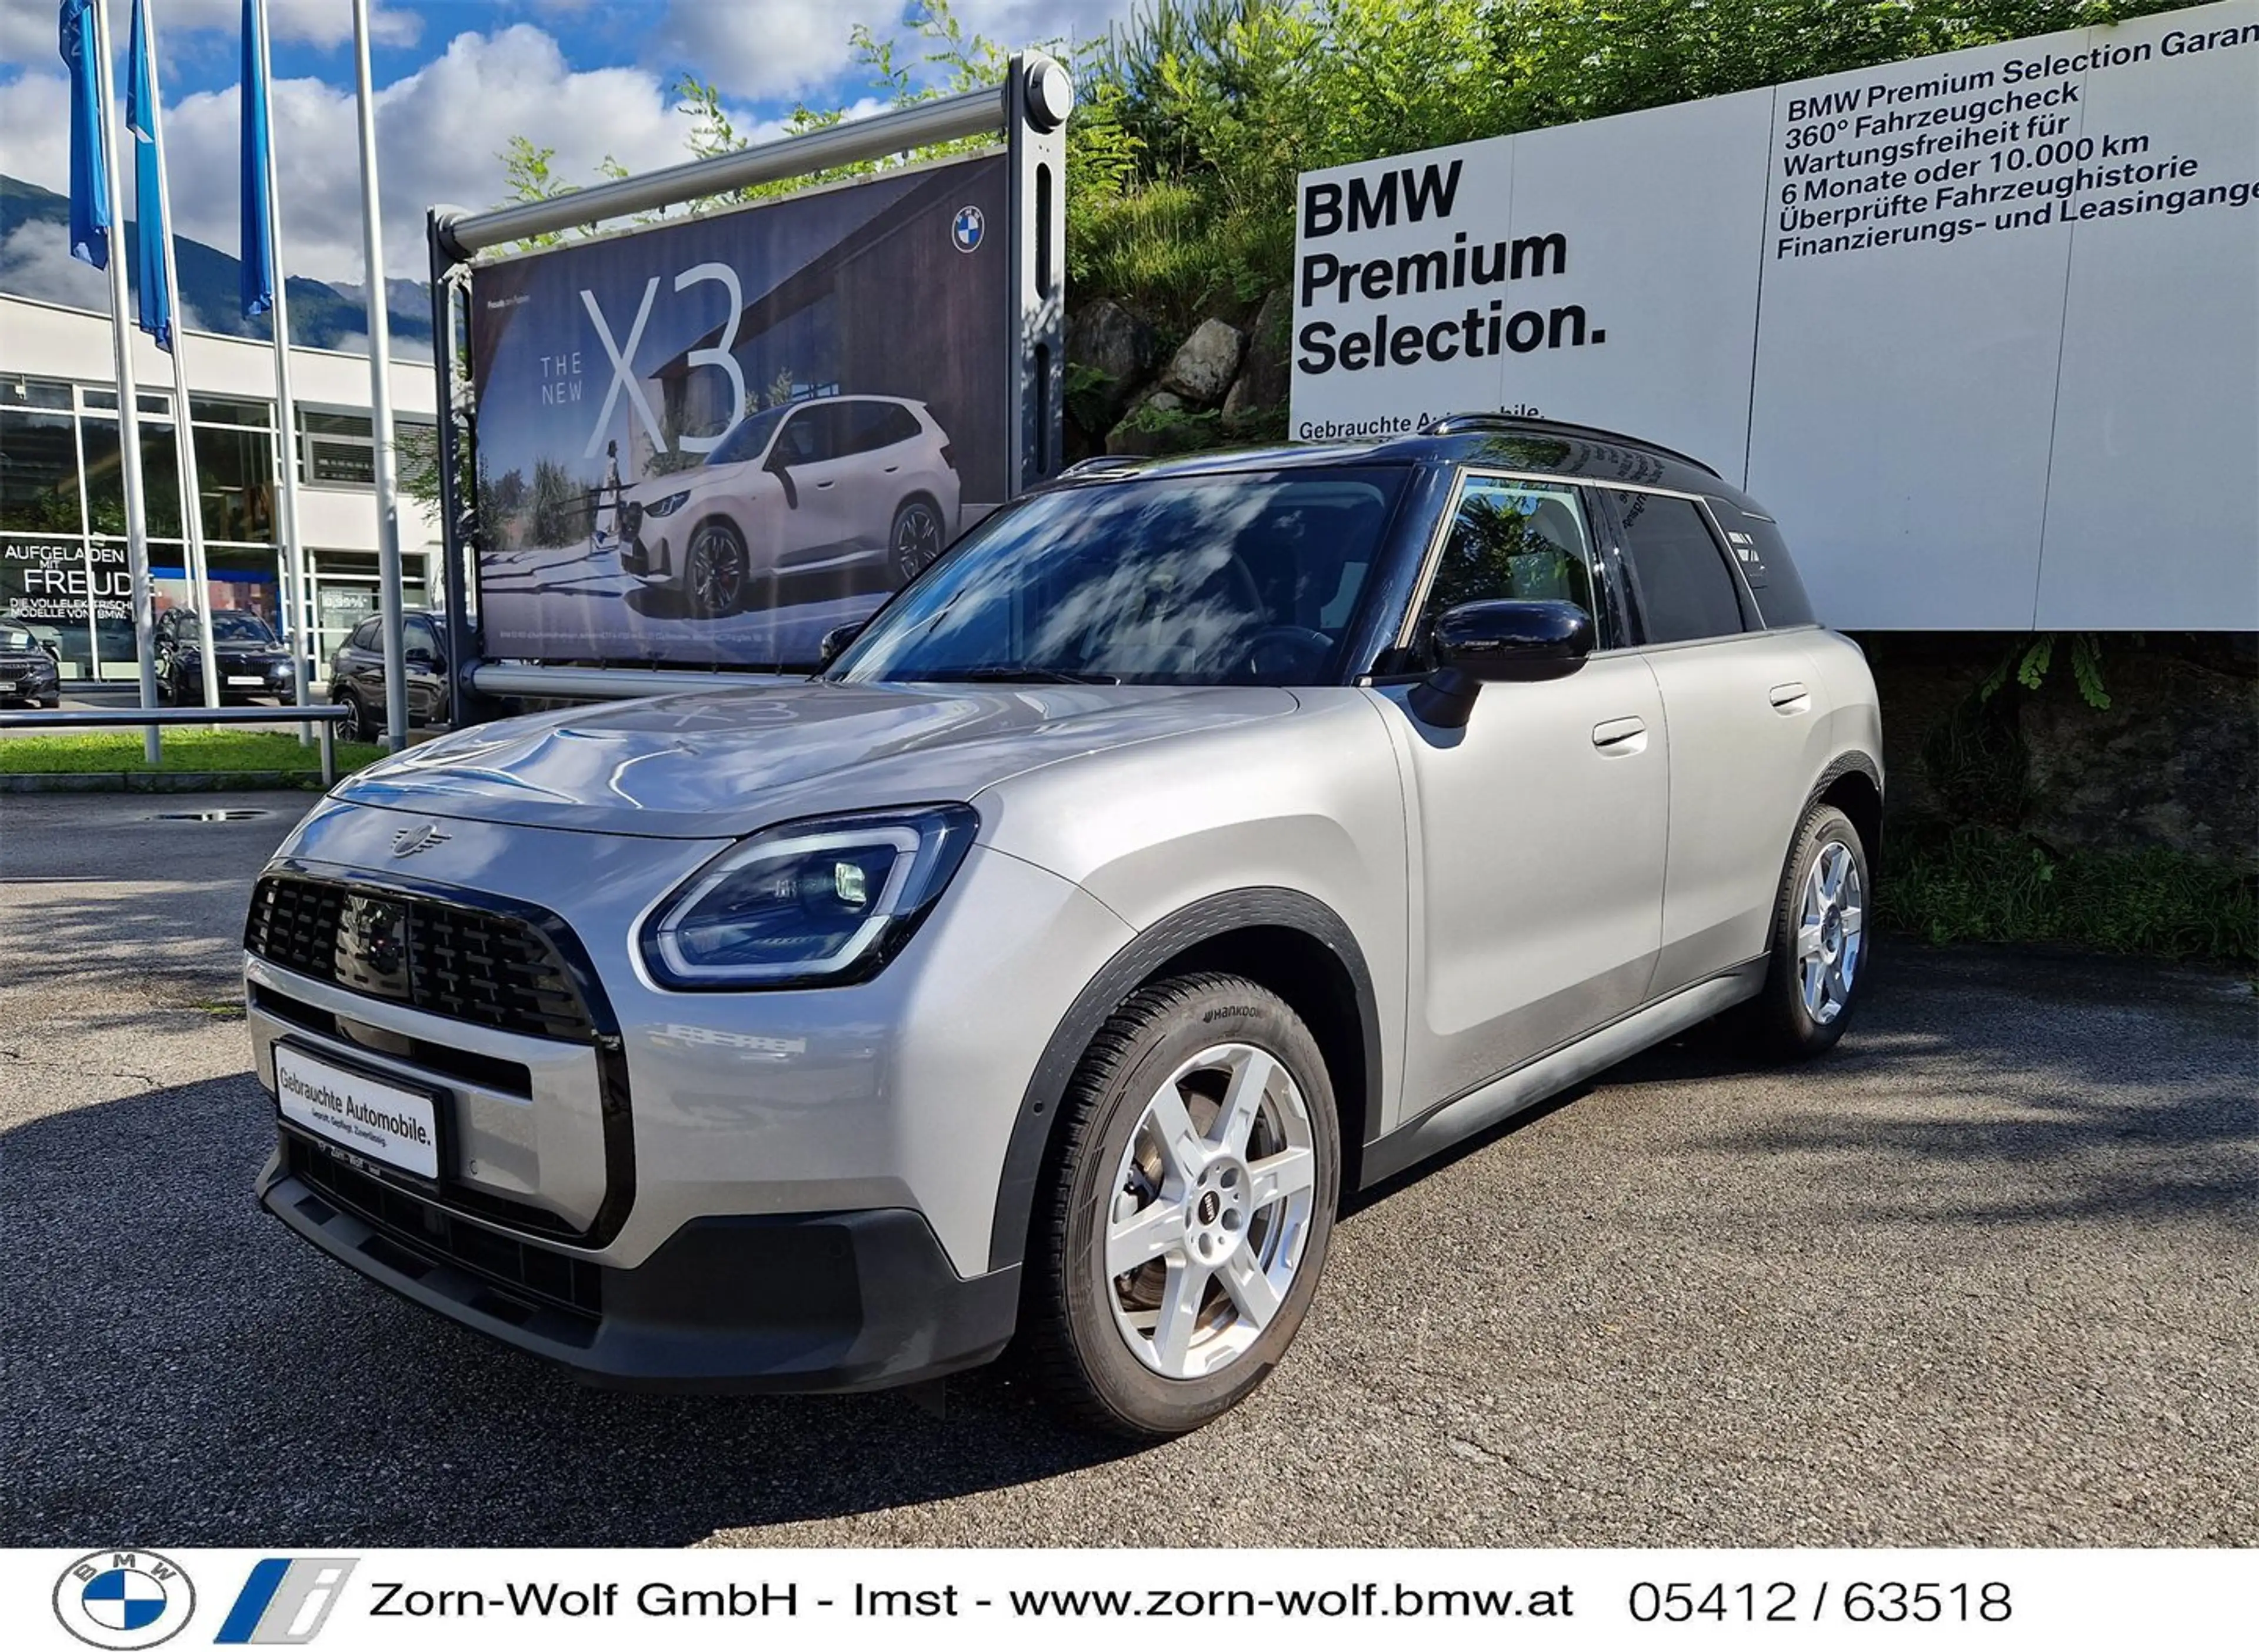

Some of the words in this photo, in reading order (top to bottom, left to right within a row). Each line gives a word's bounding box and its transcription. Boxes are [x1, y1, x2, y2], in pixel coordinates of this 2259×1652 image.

[1785, 119, 1848, 149] 360°
[1855, 81, 2080, 138] Fahrzeugcheck
[1788, 89, 1861, 122] BMW
[1868, 69, 1994, 108] Premium
[2003, 44, 2151, 84] Selection
[1782, 183, 1797, 205] 6
[1804, 170, 1907, 202] Monate
[1914, 159, 1981, 184] oder
[1990, 138, 2094, 172] 10.000
[2102, 135, 2149, 157] km
[1784, 121, 2019, 176] Wartungsfreiheit
[2027, 113, 2070, 139] für
[1304, 159, 1463, 239] BMW
[1780, 195, 1928, 231] Überprüfte
[1936, 156, 2198, 209] Fahrzeughistorie
[1777, 218, 1987, 259] Finanzierungs-
[1995, 202, 2051, 230] und
[1302, 231, 1567, 308] Premium
[541, 352, 582, 378] THE
[579, 262, 745, 458] X3
[1297, 300, 1606, 374] Selection.
[542, 379, 582, 405] NEW
[1300, 416, 1411, 440] Gebrauchte
[5, 544, 125, 563] AUFGELADEN
[40, 560, 60, 569] MIT
[11, 608, 65, 618] MODELLE
[279, 1067, 342, 1113] Gebrauchte
[346, 1095, 431, 1146] Automobile.
